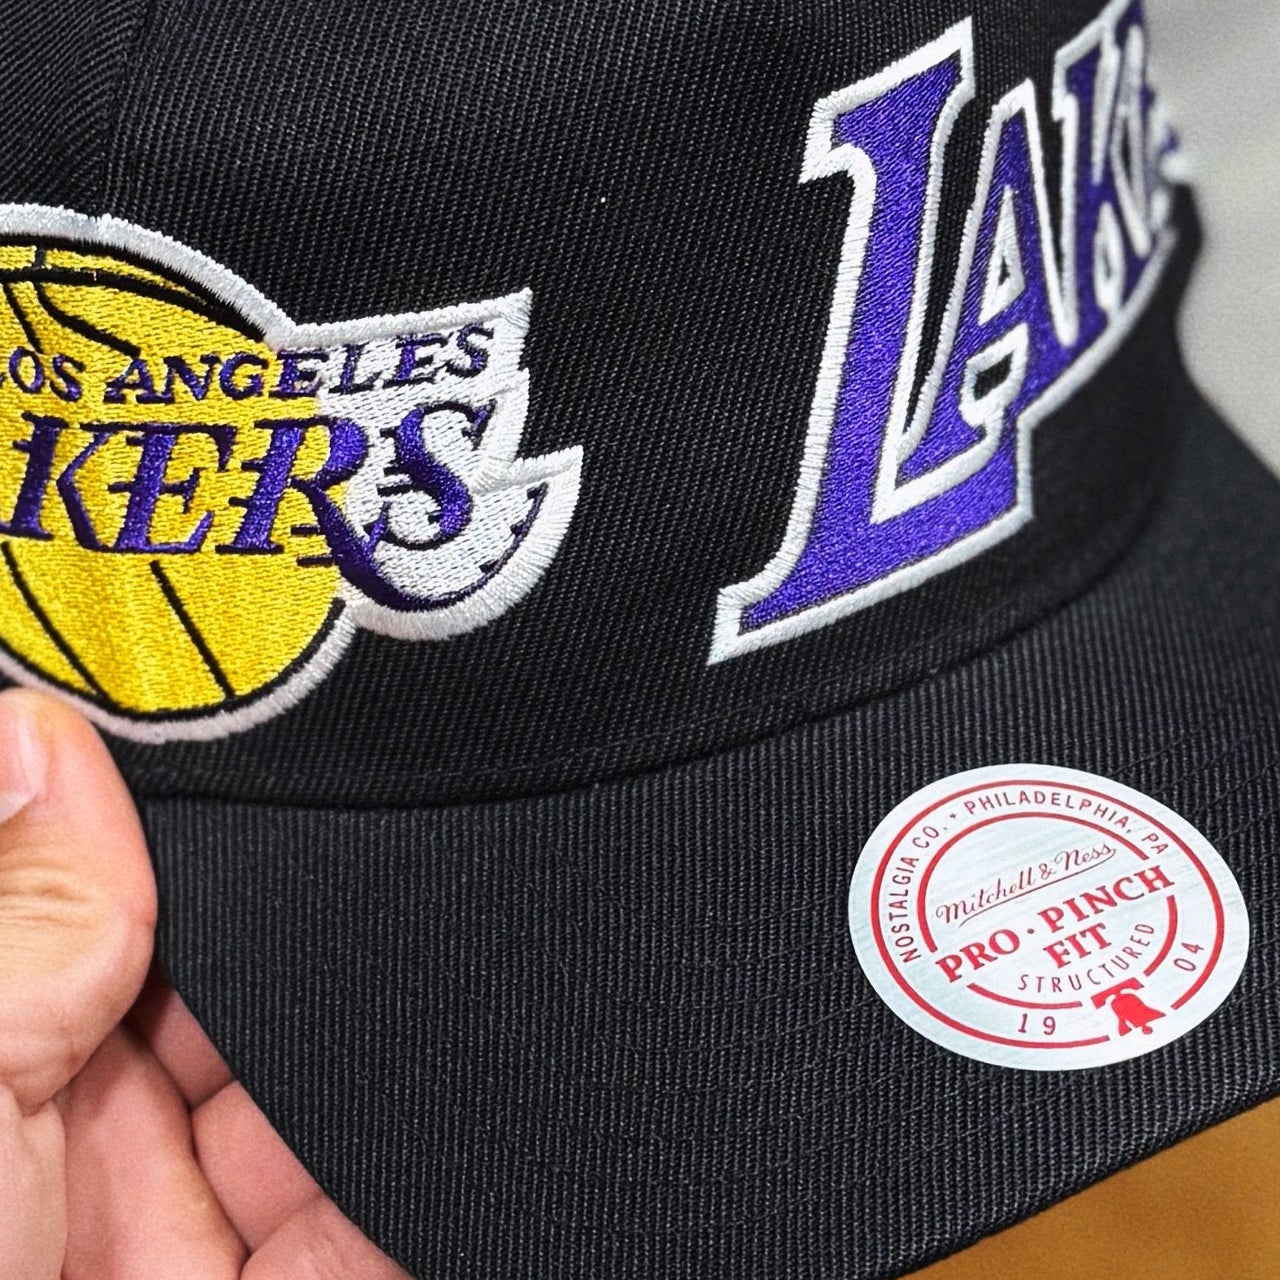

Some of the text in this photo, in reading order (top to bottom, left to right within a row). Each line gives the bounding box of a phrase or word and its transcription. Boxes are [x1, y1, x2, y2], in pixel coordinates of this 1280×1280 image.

[105, 320, 503, 406] ANGELES
[888, 855, 922, 964] NOSTALGIA
[912, 825, 948, 849] CO.
[1141, 832, 1170, 855] PA
[934, 864, 1176, 985] PRO PINCH
[935, 843, 1114, 924] Mitchell & Ness
[1017, 921, 1156, 994] STRUCTURED
[1017, 941, 1206, 1036] 19 04
[1042, 921, 1113, 970] FIT
